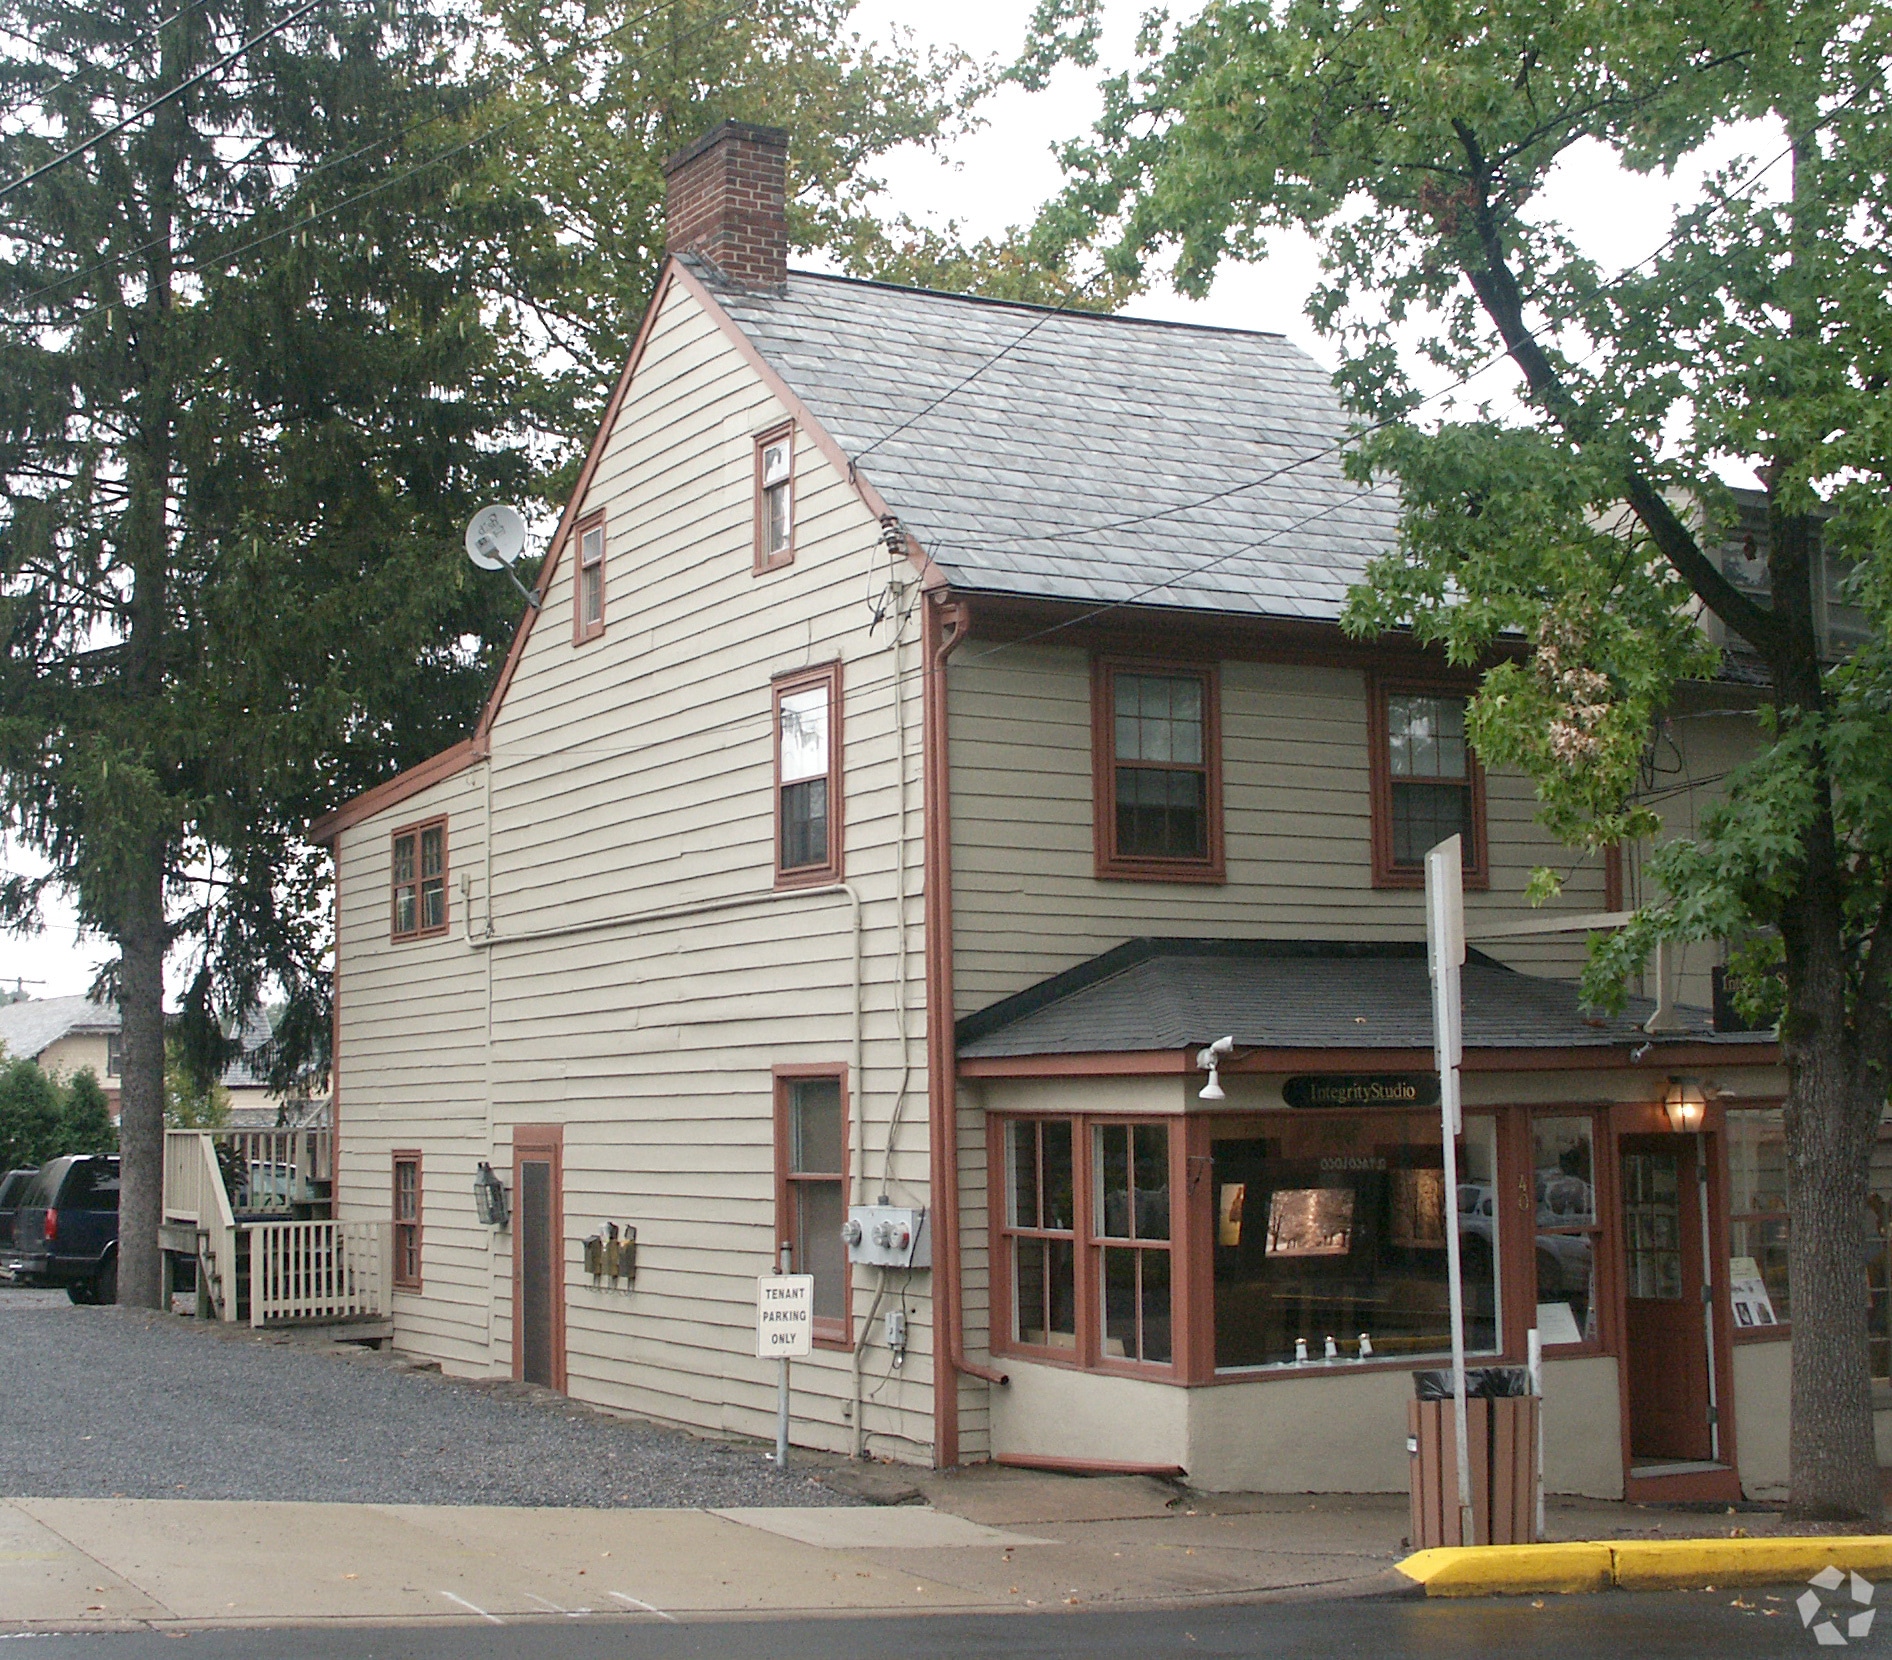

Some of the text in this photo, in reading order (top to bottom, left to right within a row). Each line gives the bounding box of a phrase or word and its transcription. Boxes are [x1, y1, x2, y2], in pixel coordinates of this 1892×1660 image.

[1518, 1174, 1529, 1211] 40
[766, 1288, 805, 1299] TENANT
[763, 1310, 807, 1322] PARKING
[771, 1333, 796, 1345] ONLY
